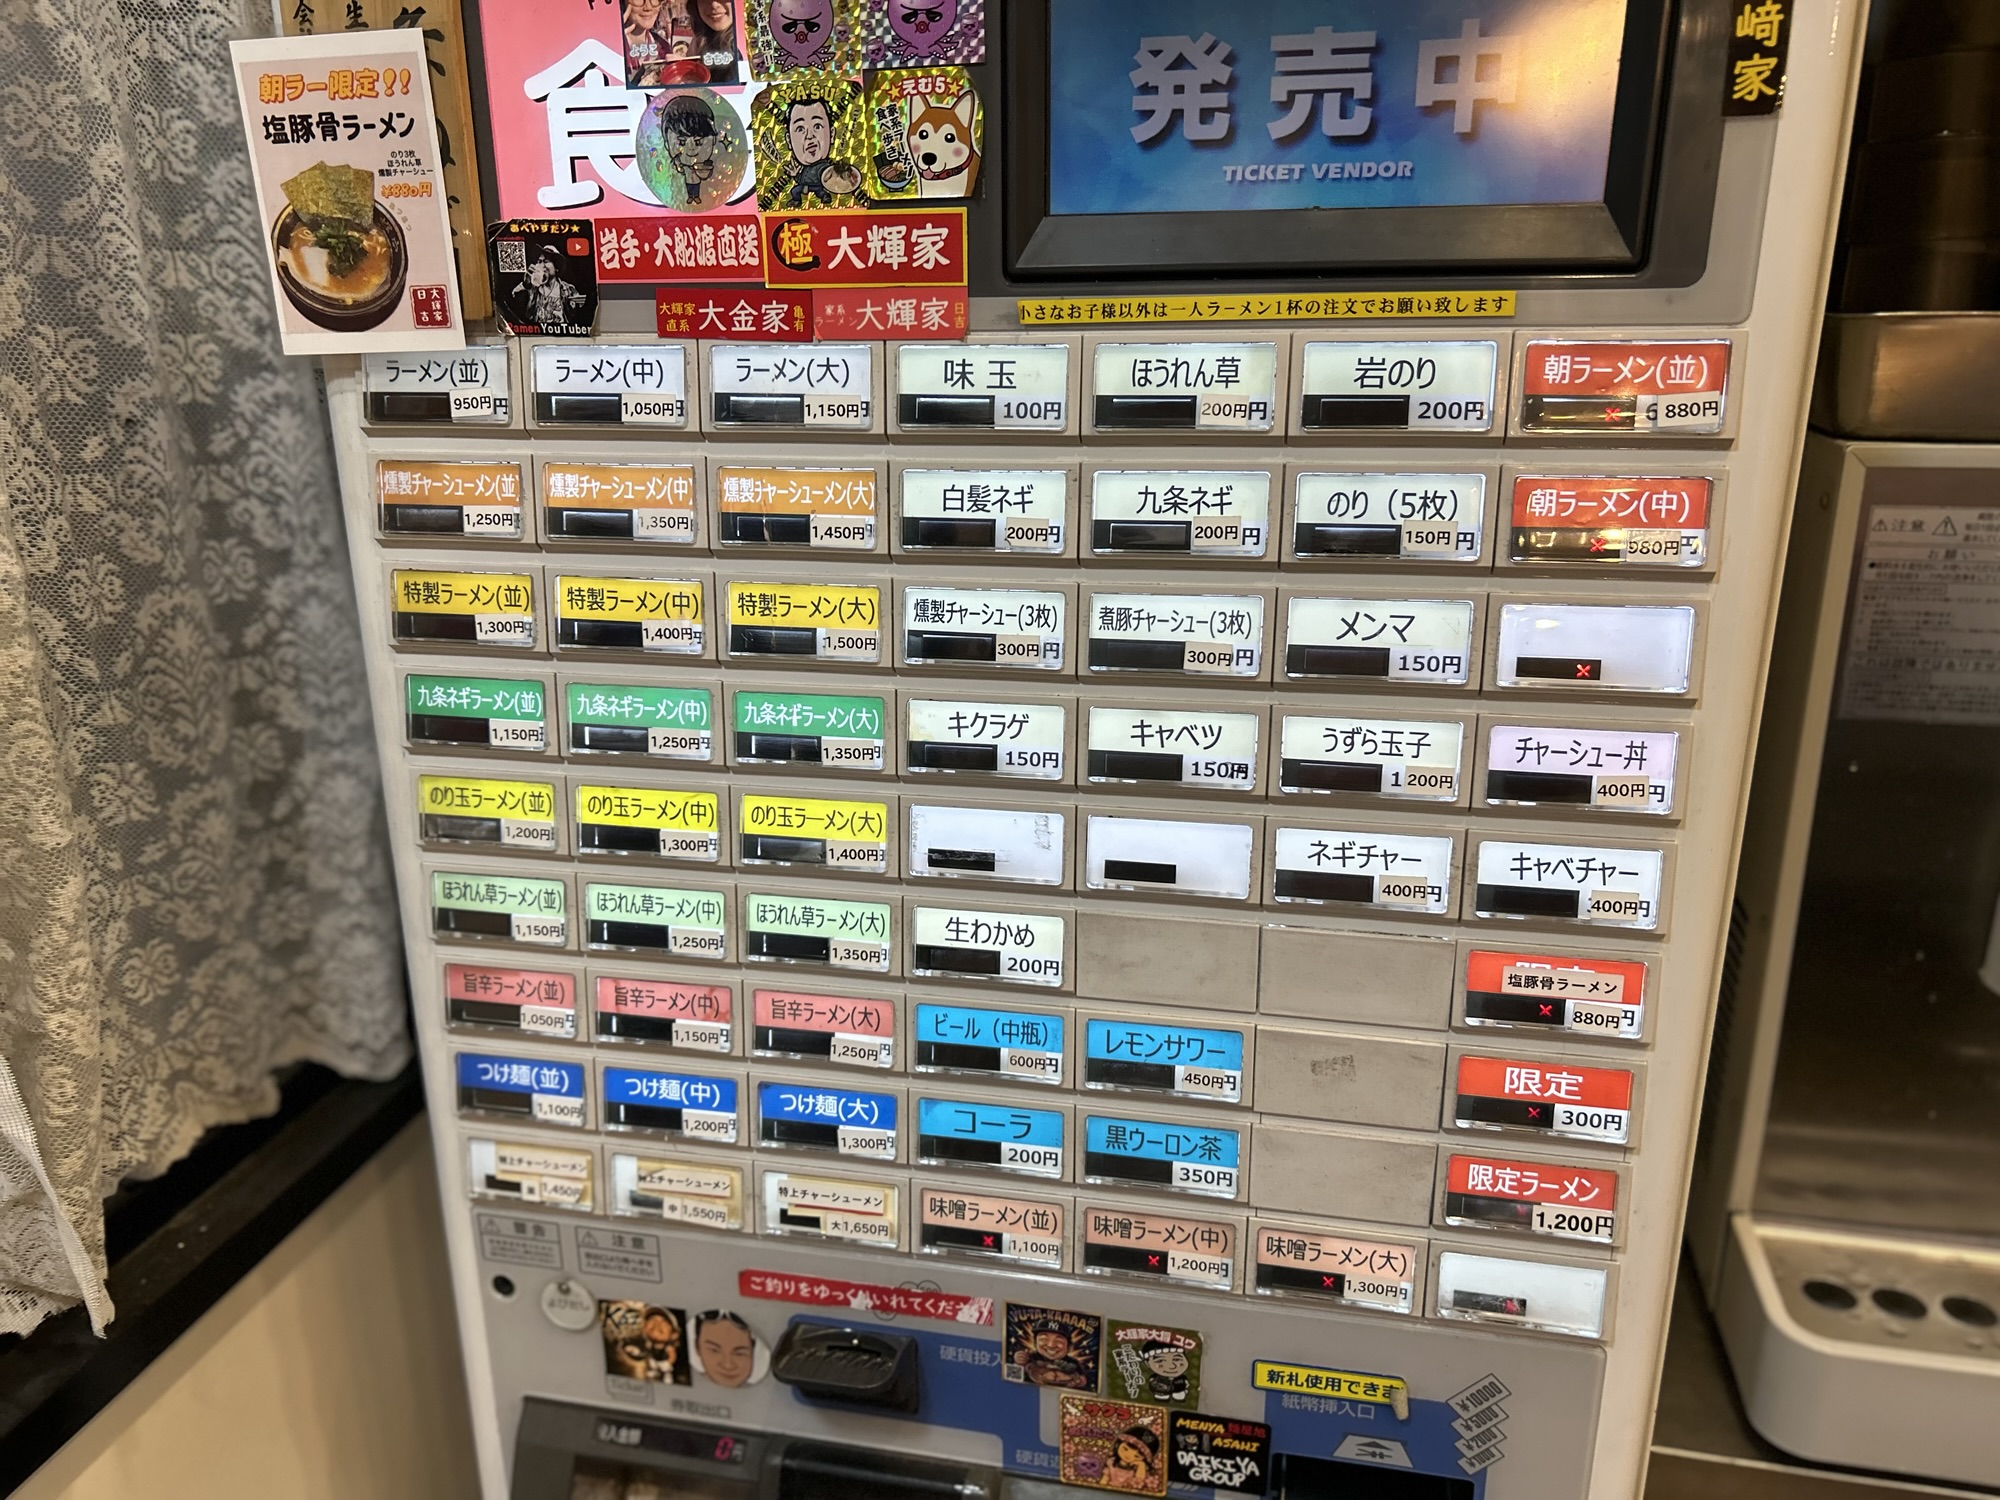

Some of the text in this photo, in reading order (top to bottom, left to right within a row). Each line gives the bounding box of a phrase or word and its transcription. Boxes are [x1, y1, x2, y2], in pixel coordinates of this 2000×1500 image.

[1129, 18, 1522, 144] 発売中
[779, 85, 836, 103] YASU
[262, 111, 415, 145] 塩豚骨ラーメン
[1223, 161, 1414, 181] TICKET VENDOR
[780, 223, 814, 264] 極
[827, 226, 950, 271] 大輝家
[660, 302, 696, 316] 大輝家
[699, 300, 790, 332] 大金家
[856, 297, 950, 331] 大輝家
[954, 302, 965, 329] 日吉
[666, 319, 690, 332] 直系
[386, 358, 488, 387] ラーメン(並)
[556, 358, 664, 388] ラーメン(中)
[736, 357, 850, 388] ラーメン(大)
[1132, 356, 1241, 389] ほうれん草
[1353, 356, 1437, 389] 岩のり
[1543, 355, 1708, 389] 朝ラーメン(並)
[454, 396, 491, 410] 950円
[622, 402, 674, 417] 1,050円
[805, 404, 859, 419] 1,150円
[1003, 402, 1061, 420] 100円
[1201, 402, 1247, 418] 200円
[1417, 401, 1484, 421] 200円
[1664, 400, 1719, 418] 880円
[942, 484, 1034, 514] 白髪ネギ
[1136, 484, 1233, 516] 九条ネギ
[1529, 488, 1690, 523] 朝ラーメン(中)
[464, 513, 513, 527] 1,250円
[812, 525, 865, 541] 1,450円
[1007, 526, 1048, 541] 200円
[1194, 525, 1238, 540] 200円
[1405, 530, 1451, 546] 150円
[404, 580, 530, 611] 特製ラーメン(並)
[567, 586, 698, 619] 特製ラーメン(中)
[737, 592, 875, 625] 特製ラーメン(大)
[477, 621, 524, 634] 1,300円
[1098, 605, 1252, 640] 煮豚チャーシュー(3枚)
[1335, 611, 1415, 643] メンマ
[643, 627, 693, 641] 1,400円
[825, 636, 877, 651] 1,500円
[997, 643, 1039, 657] 300円
[1398, 655, 1461, 675] 150円
[417, 685, 542, 717] 九条ネギラーメン(並)
[577, 693, 707, 726] 九条ネギラーメン(中)
[744, 702, 879, 735] 九条ネギラーメン(大)
[947, 710, 1029, 740] キクラゲ
[492, 728, 539, 742] 1,150円
[651, 736, 700, 750] 1,250円
[1130, 719, 1222, 750] キャベツ
[1322, 727, 1431, 759] うずら玉子
[823, 747, 874, 761] 1,350円
[1005, 750, 1059, 769] 150円
[1515, 737, 1648, 771] チャーシュー丼
[1407, 773, 1453, 789] 200円
[1597, 782, 1645, 798] 400円
[430, 786, 552, 816] のり玉ラーメン(並)
[588, 795, 715, 827] のり玉ラーメン(中)
[752, 805, 883, 838] のり玉ラーメン(大)
[505, 827, 550, 841] 1,200円
[661, 838, 709, 852] 1,300円
[828, 848, 879, 862] 1,400円
[1306, 838, 1422, 872] ネギチャー
[1511, 852, 1639, 886] キャベチャー
[443, 881, 562, 913] ほうれん草ラーメン(並)
[1382, 883, 1426, 899] 400円
[597, 891, 721, 925] ほうれん草ラーメン(中)
[1592, 898, 1637, 915] 400円
[515, 923, 560, 938] 1,150円
[756, 902, 886, 938] ほうれん草ラーメン(大)
[671, 935, 719, 950] 1,250円
[945, 916, 1035, 948] 生わかめ
[832, 948, 880, 963] 1,350円
[1007, 957, 1059, 976] 200円
[463, 972, 566, 1004] 旨辛ラーメン(並)
[1507, 973, 1618, 995] 塩豚骨ラーメン
[615, 985, 720, 1019] 旨辛ラーメン(中)
[521, 1012, 564, 1028] 1,050円
[771, 998, 881, 1032] 旨辛ラーメン(大)
[1573, 1010, 1620, 1028] 880円
[673, 1030, 719, 1044] 1,150円
[1105, 1029, 1226, 1062] レモンサワー
[831, 1045, 879, 1061] 1,250円
[1009, 1055, 1046, 1070] 600円
[477, 1063, 569, 1093] つけ麺(並)
[1184, 1072, 1224, 1089] 450円
[1504, 1067, 1583, 1101] 限定
[625, 1077, 721, 1108] つけ麺(中)
[779, 1092, 879, 1125] つけ麺(大)
[683, 1119, 729, 1134] 1,200円
[954, 1110, 1032, 1139] コーラ
[1561, 1110, 1622, 1132] 300円
[841, 1137, 887, 1150] 1,300円
[1106, 1124, 1222, 1161] 黒ウーロン茶
[1008, 1148, 1058, 1167] 200円
[1179, 1167, 1233, 1187] 350円
[1468, 1164, 1600, 1202] 限定ラーメン
[930, 1197, 1057, 1235] 味噌ラーメン(並)
[1535, 1211, 1614, 1237] 1,200円
[843, 1221, 889, 1236] 1,650円
[1094, 1215, 1228, 1253] 味噌ラーメン(中)
[1011, 1239, 1059, 1256] 1,100円
[1266, 1236, 1407, 1277] 味噌ラーメン(大)
[1170, 1257, 1220, 1275] 1,200円
[1346, 1279, 1398, 1299] 1,300円
[1176, 1418, 1225, 1434] MENYA
[1212, 1437, 1260, 1452] ASAHI
[1177, 1451, 1260, 1477] DAIKIYA
[1189, 1467, 1246, 1487] GROUP
